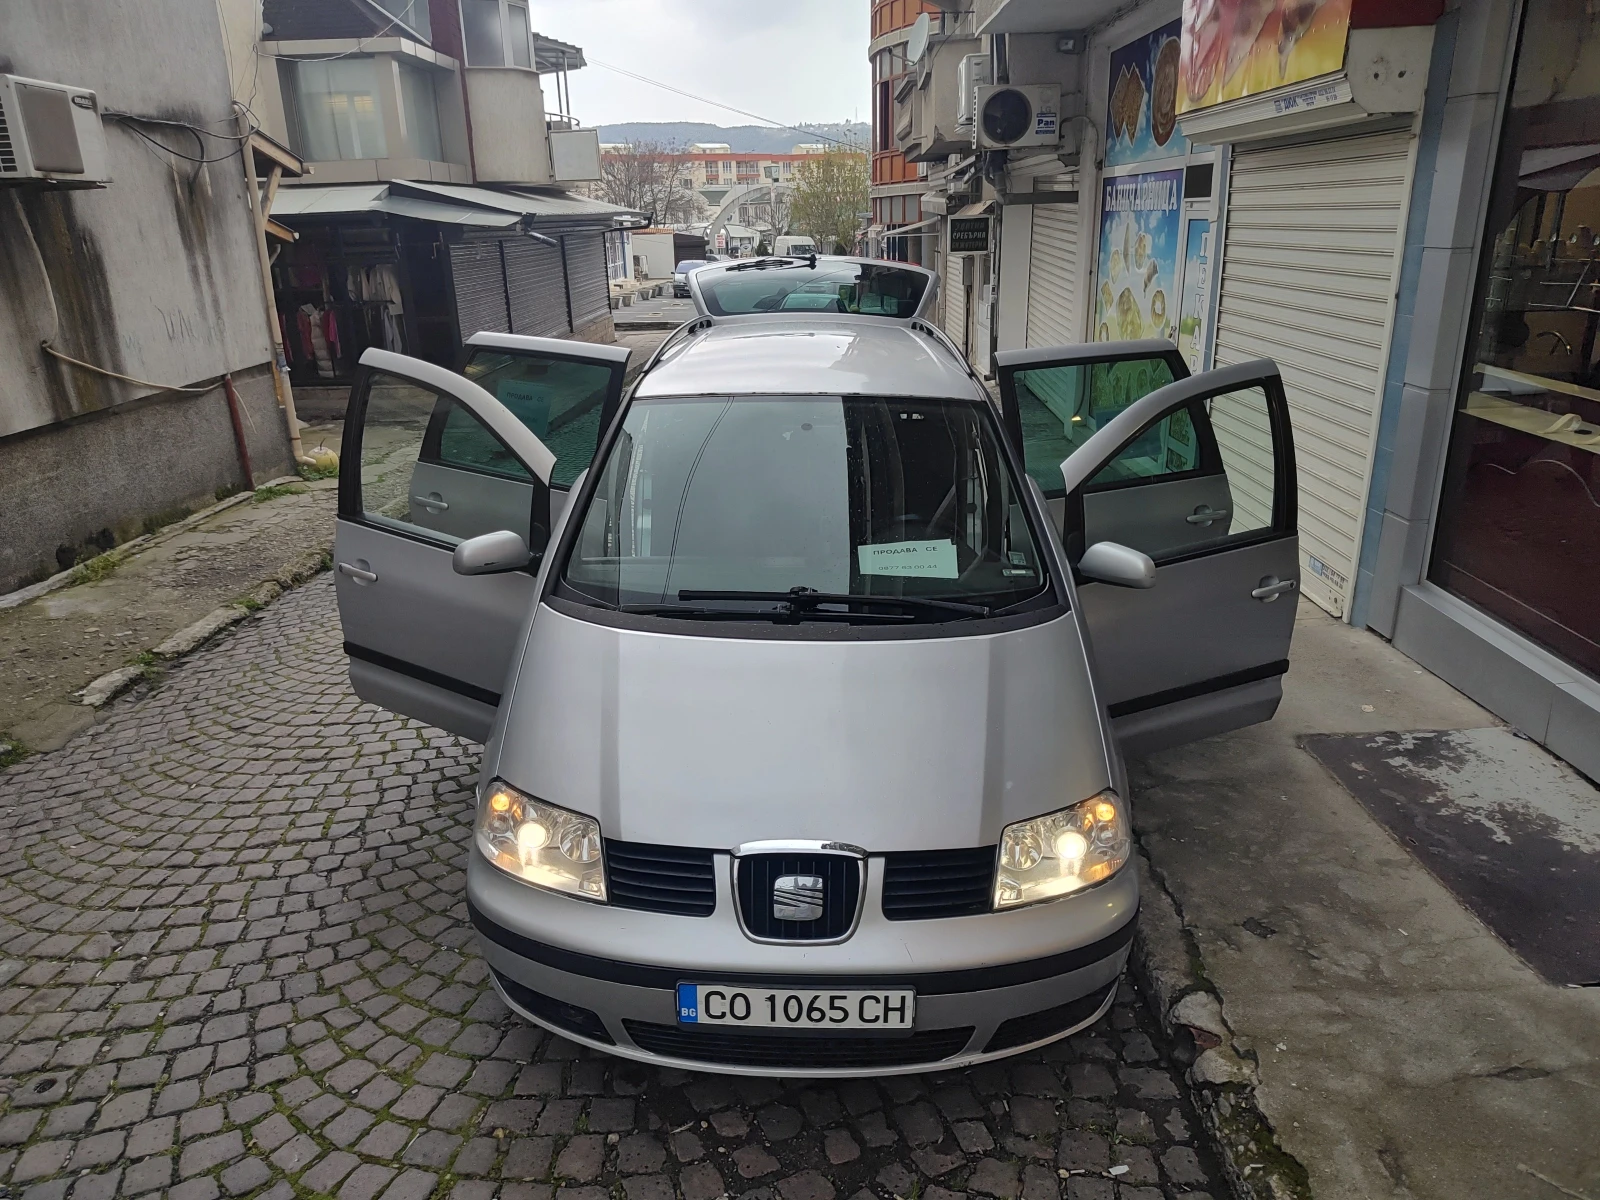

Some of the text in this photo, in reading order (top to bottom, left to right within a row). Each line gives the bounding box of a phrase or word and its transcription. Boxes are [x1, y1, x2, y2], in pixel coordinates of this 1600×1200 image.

[1105, 179, 1178, 216] БАНИЧАРНИЦА
[952, 231, 986, 240] СРЕБЪРНА
[506, 392, 533, 401] ПРОДАВА
[873, 547, 918, 556] ПРОДАВА
[681, 990, 906, 1024] BG CO 1065 CH
